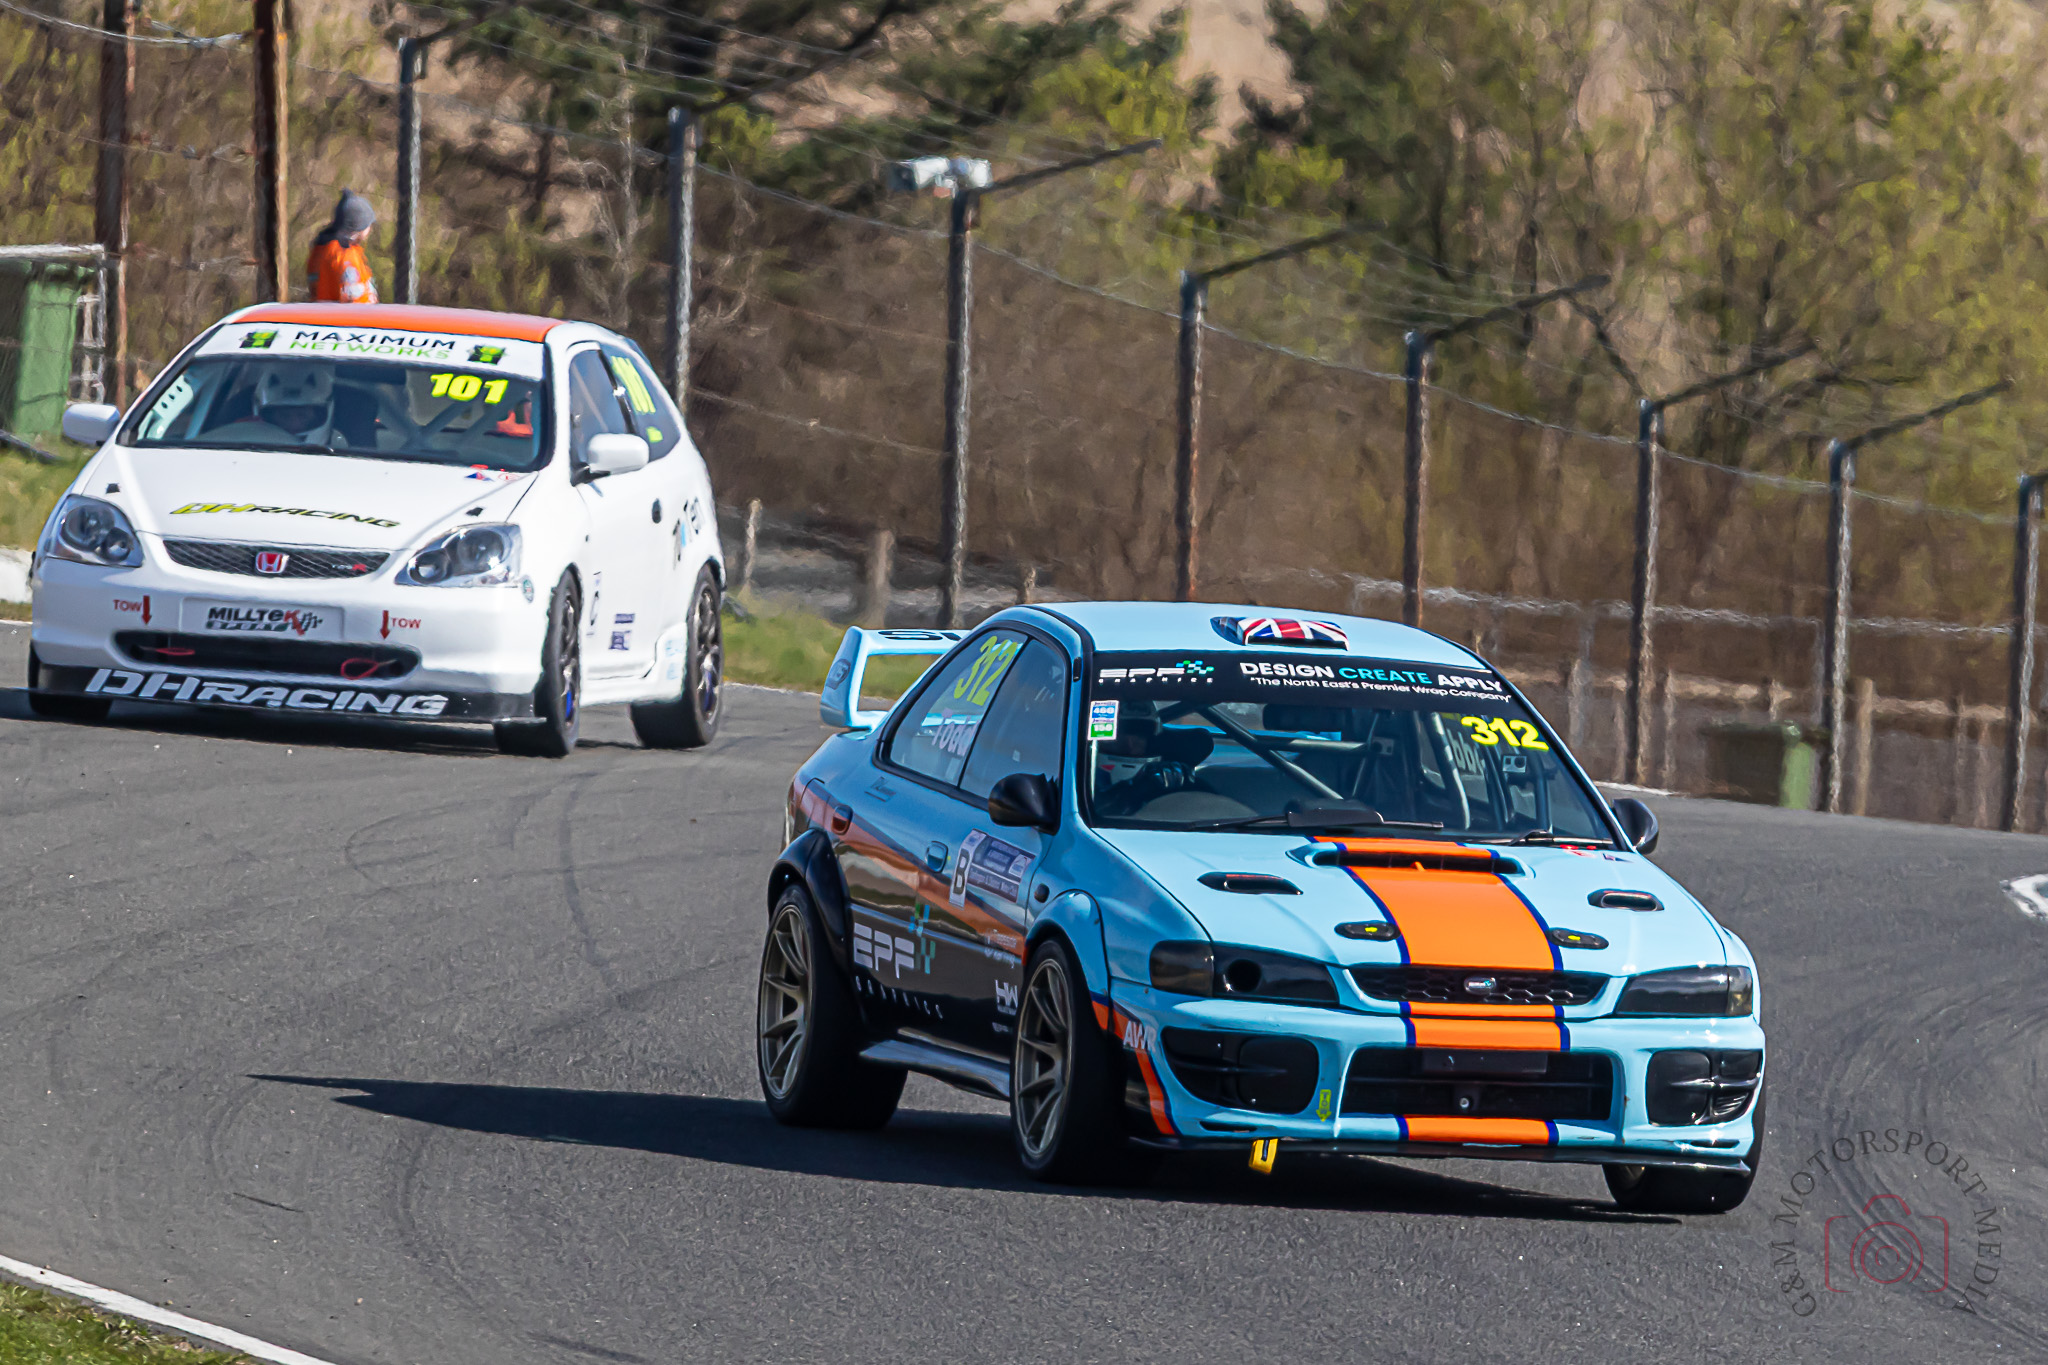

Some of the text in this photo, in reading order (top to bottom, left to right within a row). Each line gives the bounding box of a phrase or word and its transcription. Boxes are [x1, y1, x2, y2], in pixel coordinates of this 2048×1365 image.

[290, 341, 450, 359] NETWORKS
[295, 331, 456, 350] MAXIMUM
[430, 373, 509, 405] 101
[113, 599, 142, 613] TOW
[391, 617, 421, 629] TOW
[954, 636, 1018, 706] 312
[1240, 662, 1503, 692] DESIGN CREATE APPLY
[1283, 678, 1320, 688] North
[1322, 680, 1360, 690] East's
[1360, 681, 1410, 693] Premier
[1411, 685, 1449, 697] Wrap
[1461, 716, 1549, 752] 312
[1123, 1020, 1157, 1053] AWR
